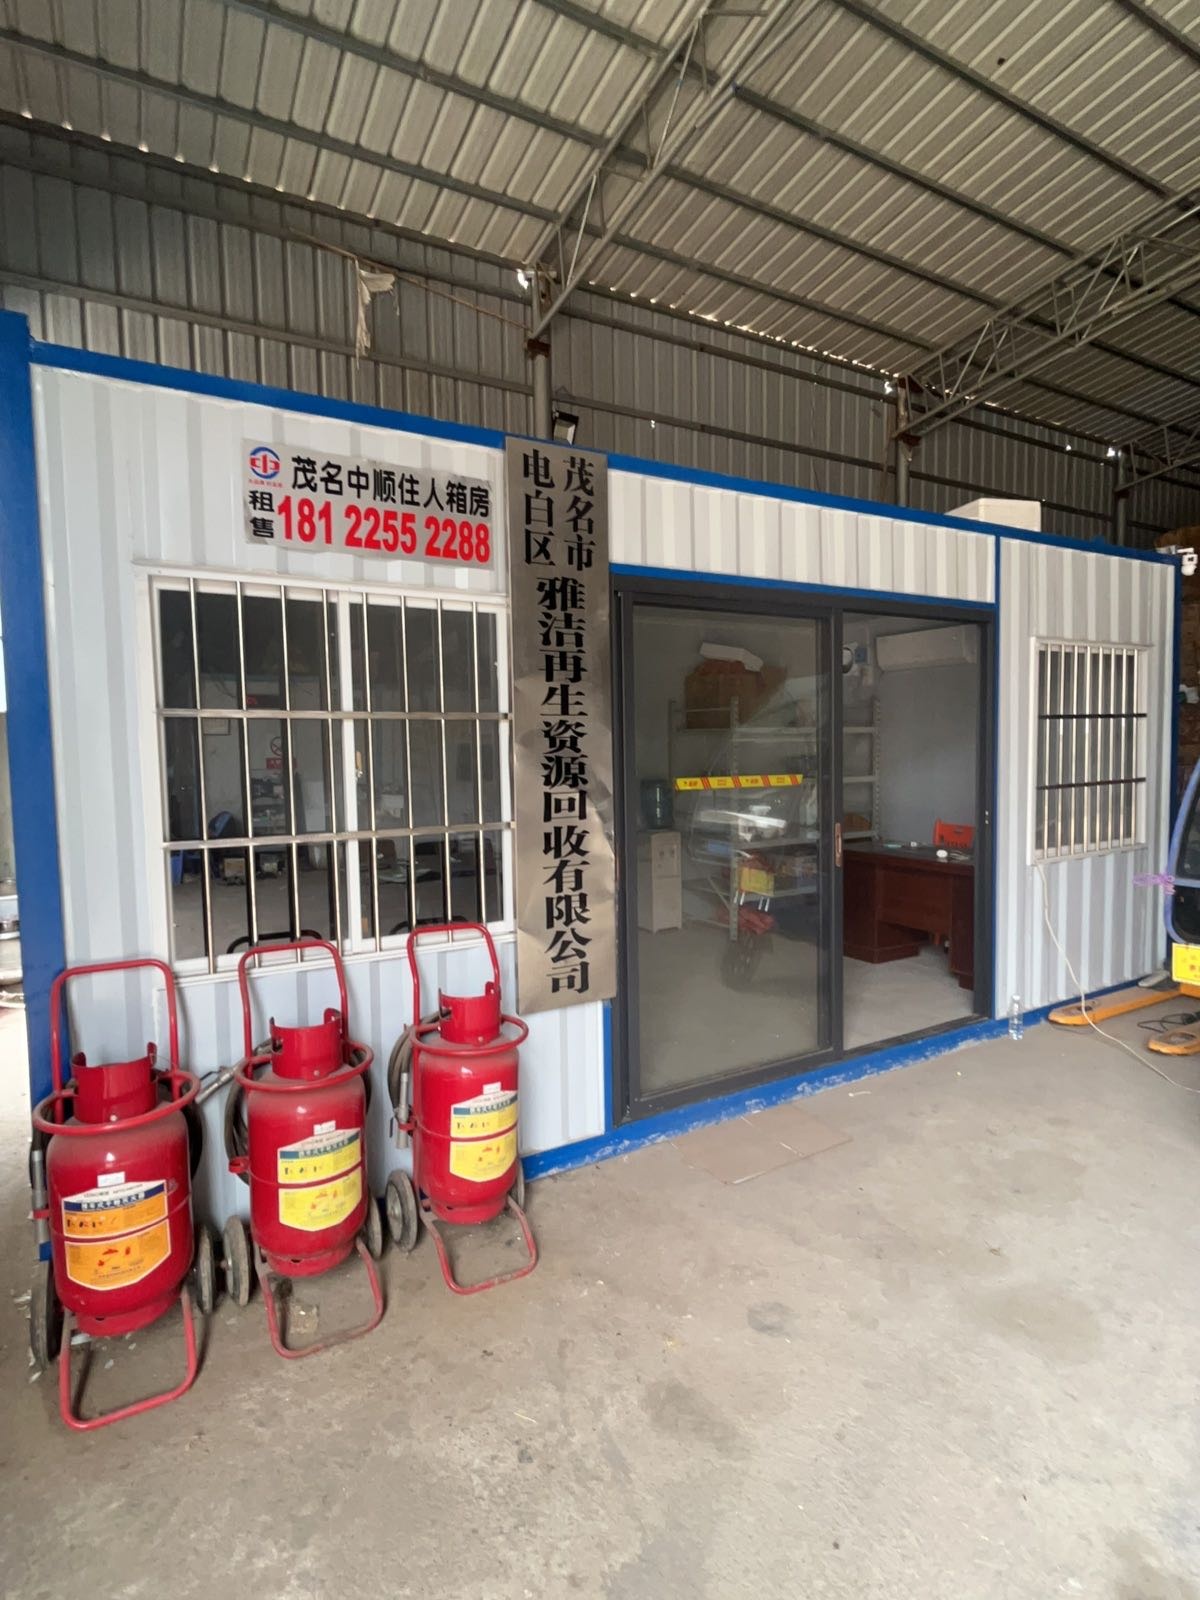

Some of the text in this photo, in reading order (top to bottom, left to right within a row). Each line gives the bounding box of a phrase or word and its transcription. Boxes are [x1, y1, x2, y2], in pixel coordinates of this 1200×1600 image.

[249, 490, 275, 539] 租售
[277, 495, 491, 565] 181 2255 2288
[292, 456, 490, 518] 茂名中顺住人箱房
[522, 448, 556, 567] 电白区
[563, 456, 596, 571] 茂名市
[536, 576, 593, 994] 雅洁再生资源回收有限公司
